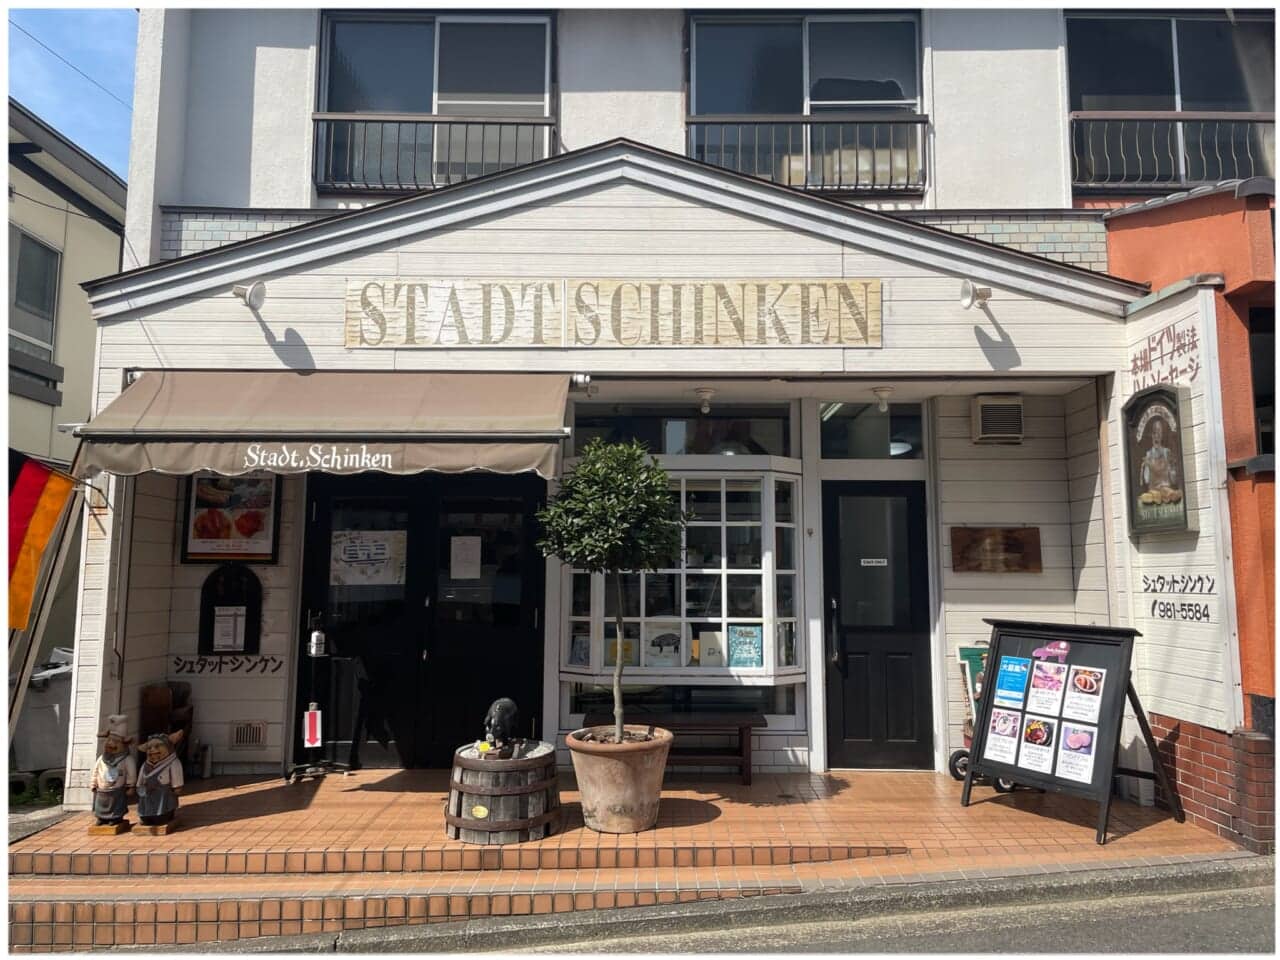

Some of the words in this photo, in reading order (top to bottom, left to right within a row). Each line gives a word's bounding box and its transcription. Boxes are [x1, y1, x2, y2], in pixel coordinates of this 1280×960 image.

[359, 281, 556, 346] STADT
[574, 281, 877, 346] SCHINKEN
[305, 444, 393, 470] Schinken
[1158, 601, 1210, 622] 981-5584
[174, 655, 283, 674] シュタットシンケン
